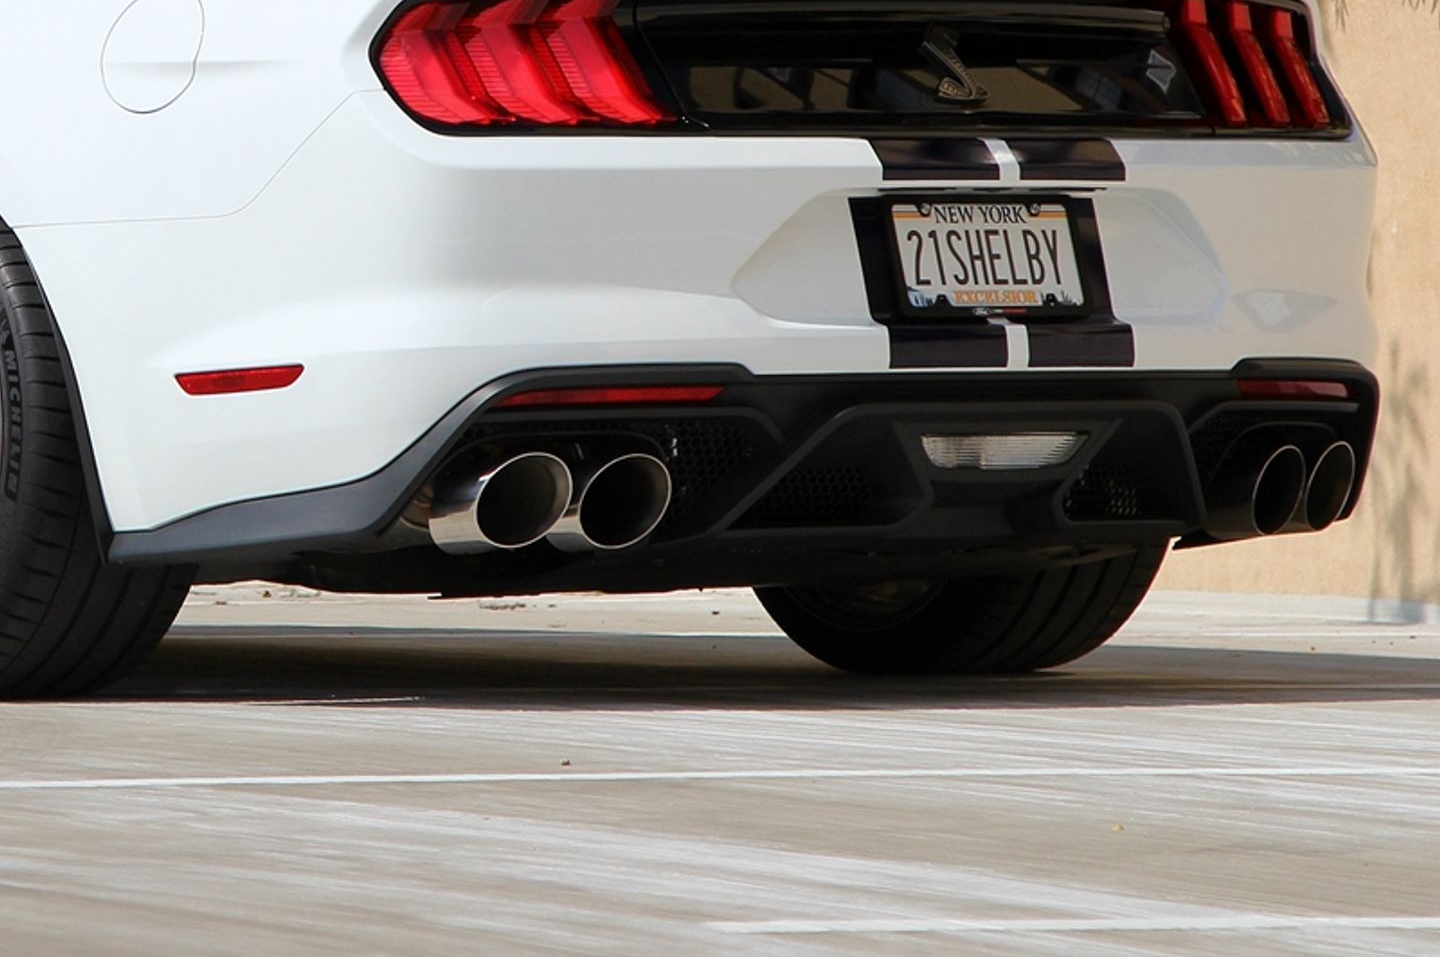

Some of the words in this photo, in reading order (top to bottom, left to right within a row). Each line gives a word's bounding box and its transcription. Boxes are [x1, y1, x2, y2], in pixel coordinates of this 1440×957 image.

[934, 205, 976, 224] NEW
[977, 205, 1027, 224] YORK
[907, 229, 1062, 285] 21SHELBY
[4, 349, 22, 493] MICHELIN
